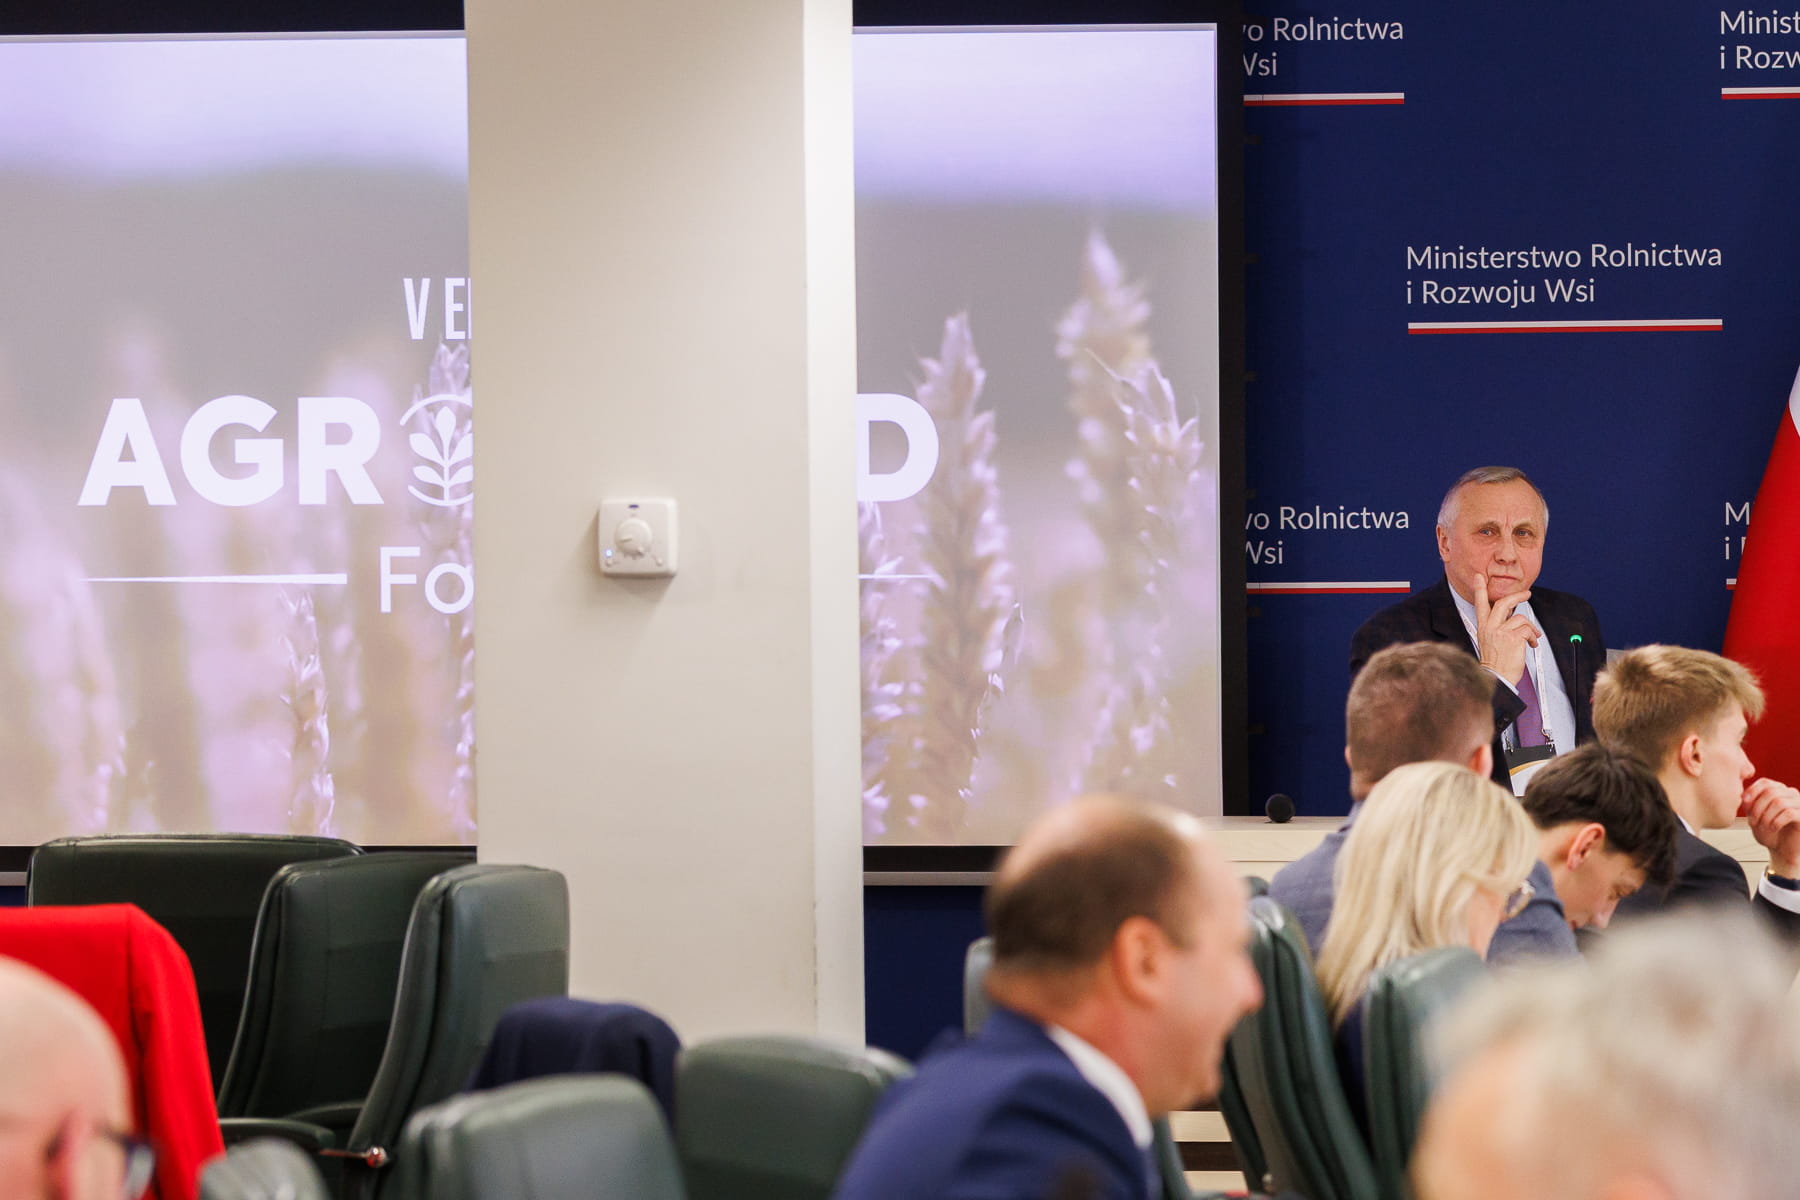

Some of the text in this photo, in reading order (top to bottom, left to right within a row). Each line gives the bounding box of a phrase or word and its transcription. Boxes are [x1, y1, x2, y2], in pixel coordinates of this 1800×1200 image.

[1274, 16, 1403, 41] Rolnictwa
[1720, 45, 1726, 70] i
[1407, 242, 1722, 270] Ministerstwo Rolnictwa
[1406, 278, 1595, 309] i Rozwoju Wsi
[1280, 505, 1409, 530] Rolnictwa
[1724, 536, 1730, 560] i
